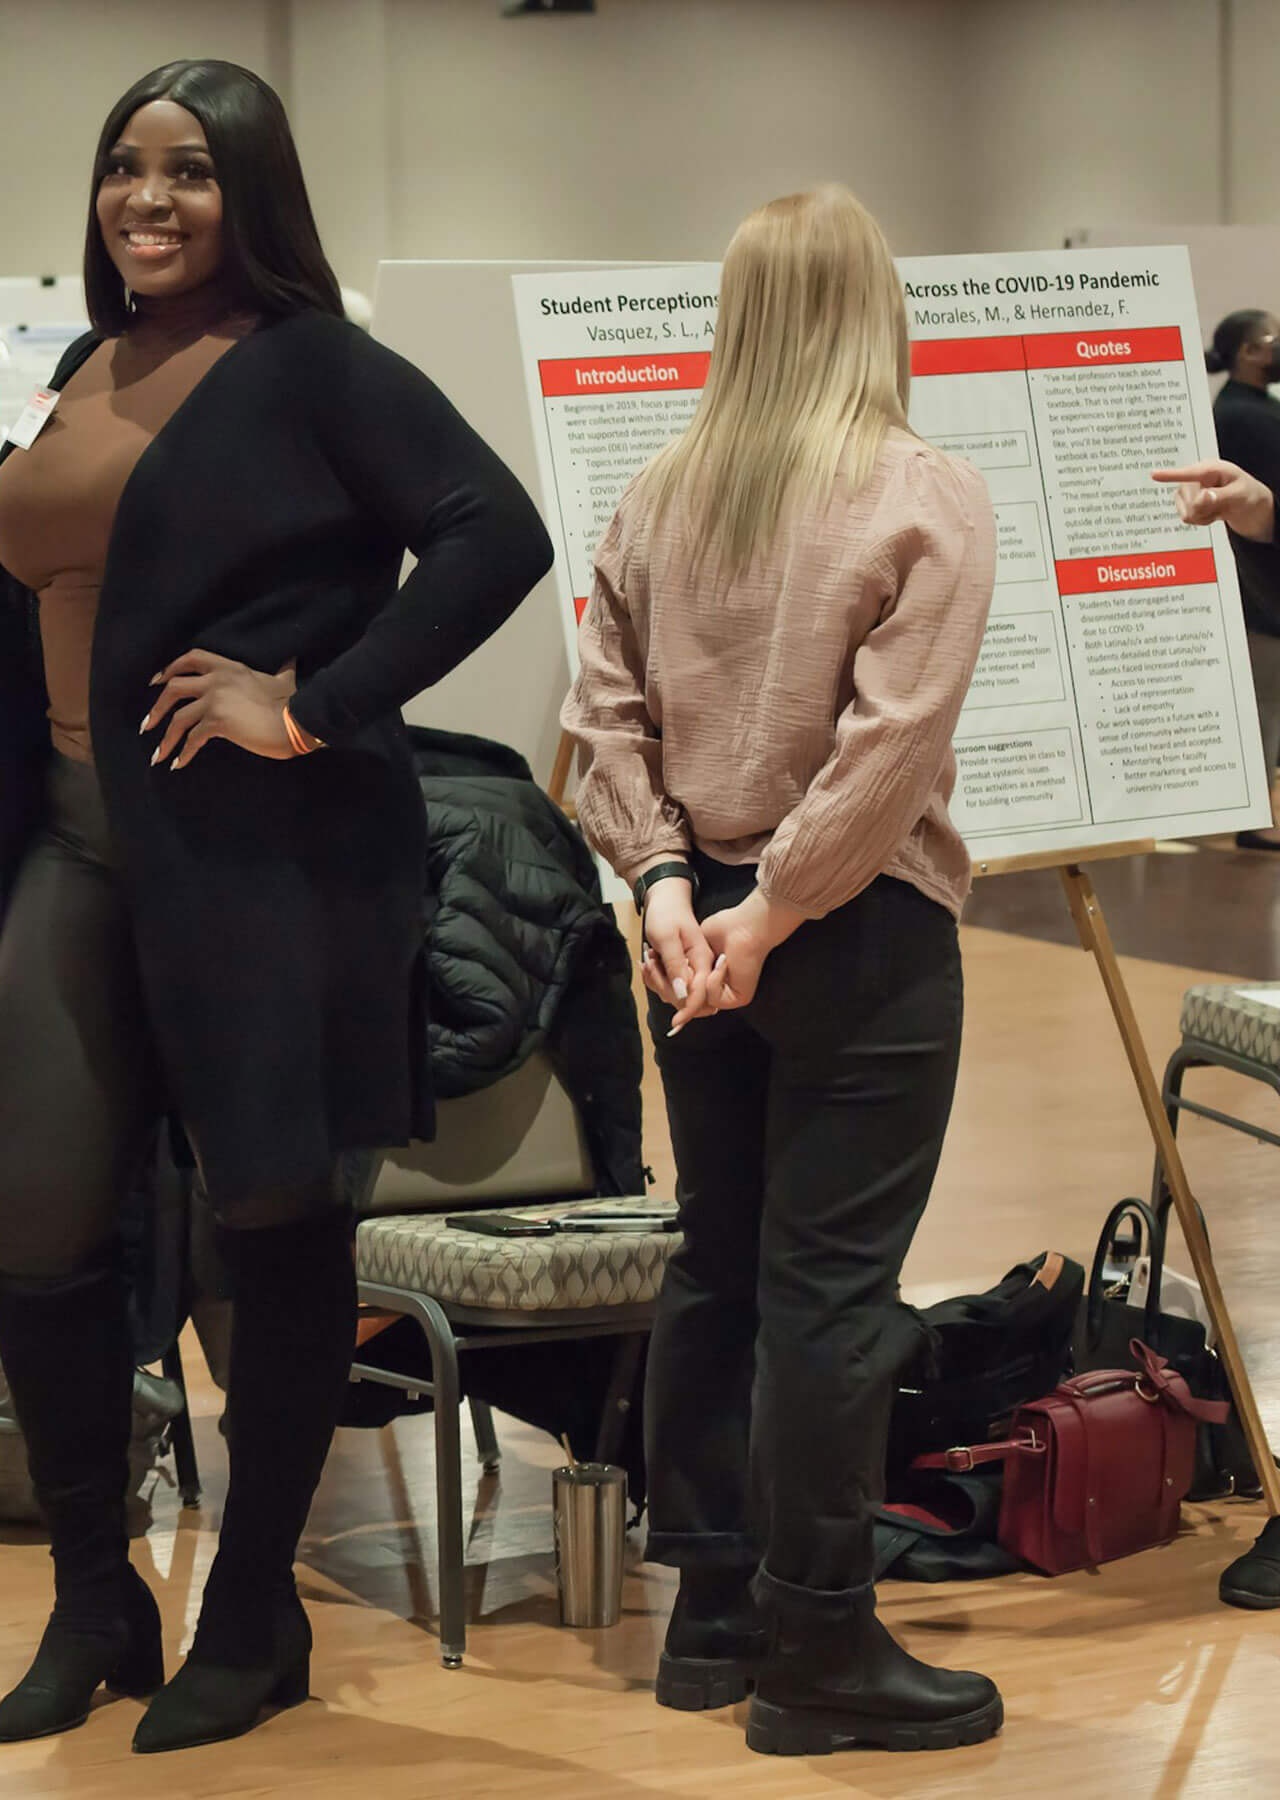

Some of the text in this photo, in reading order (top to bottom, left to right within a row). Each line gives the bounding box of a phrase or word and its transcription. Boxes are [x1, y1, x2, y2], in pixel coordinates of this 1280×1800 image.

[904, 269, 1159, 298] Across the COVID-19 Pandemic
[540, 295, 612, 315] Student
[914, 299, 1129, 325] Morales, M., & Hernandez, F.
[586, 325, 658, 343] Vasquez,
[661, 321, 676, 338] S.
[680, 321, 698, 339] L.,
[1075, 340, 1131, 359] Quotes
[575, 364, 678, 385] Introduction
[1061, 372, 1076, 381] had
[1077, 370, 1117, 382] professors
[1117, 368, 1139, 378] teach
[1140, 367, 1161, 377] about
[563, 403, 605, 414] Beginning
[605, 402, 614, 410] in
[640, 399, 663, 408] focus
[663, 399, 688, 409] group
[1096, 561, 1176, 583] Discussion
[1110, 674, 1183, 688] Access to resources
[1112, 686, 1194, 701] Lack of representation
[1113, 701, 1175, 714] Lack of empathy
[1121, 751, 1207, 767] Mentoring from faculty
[1125, 779, 1199, 794] university resources
